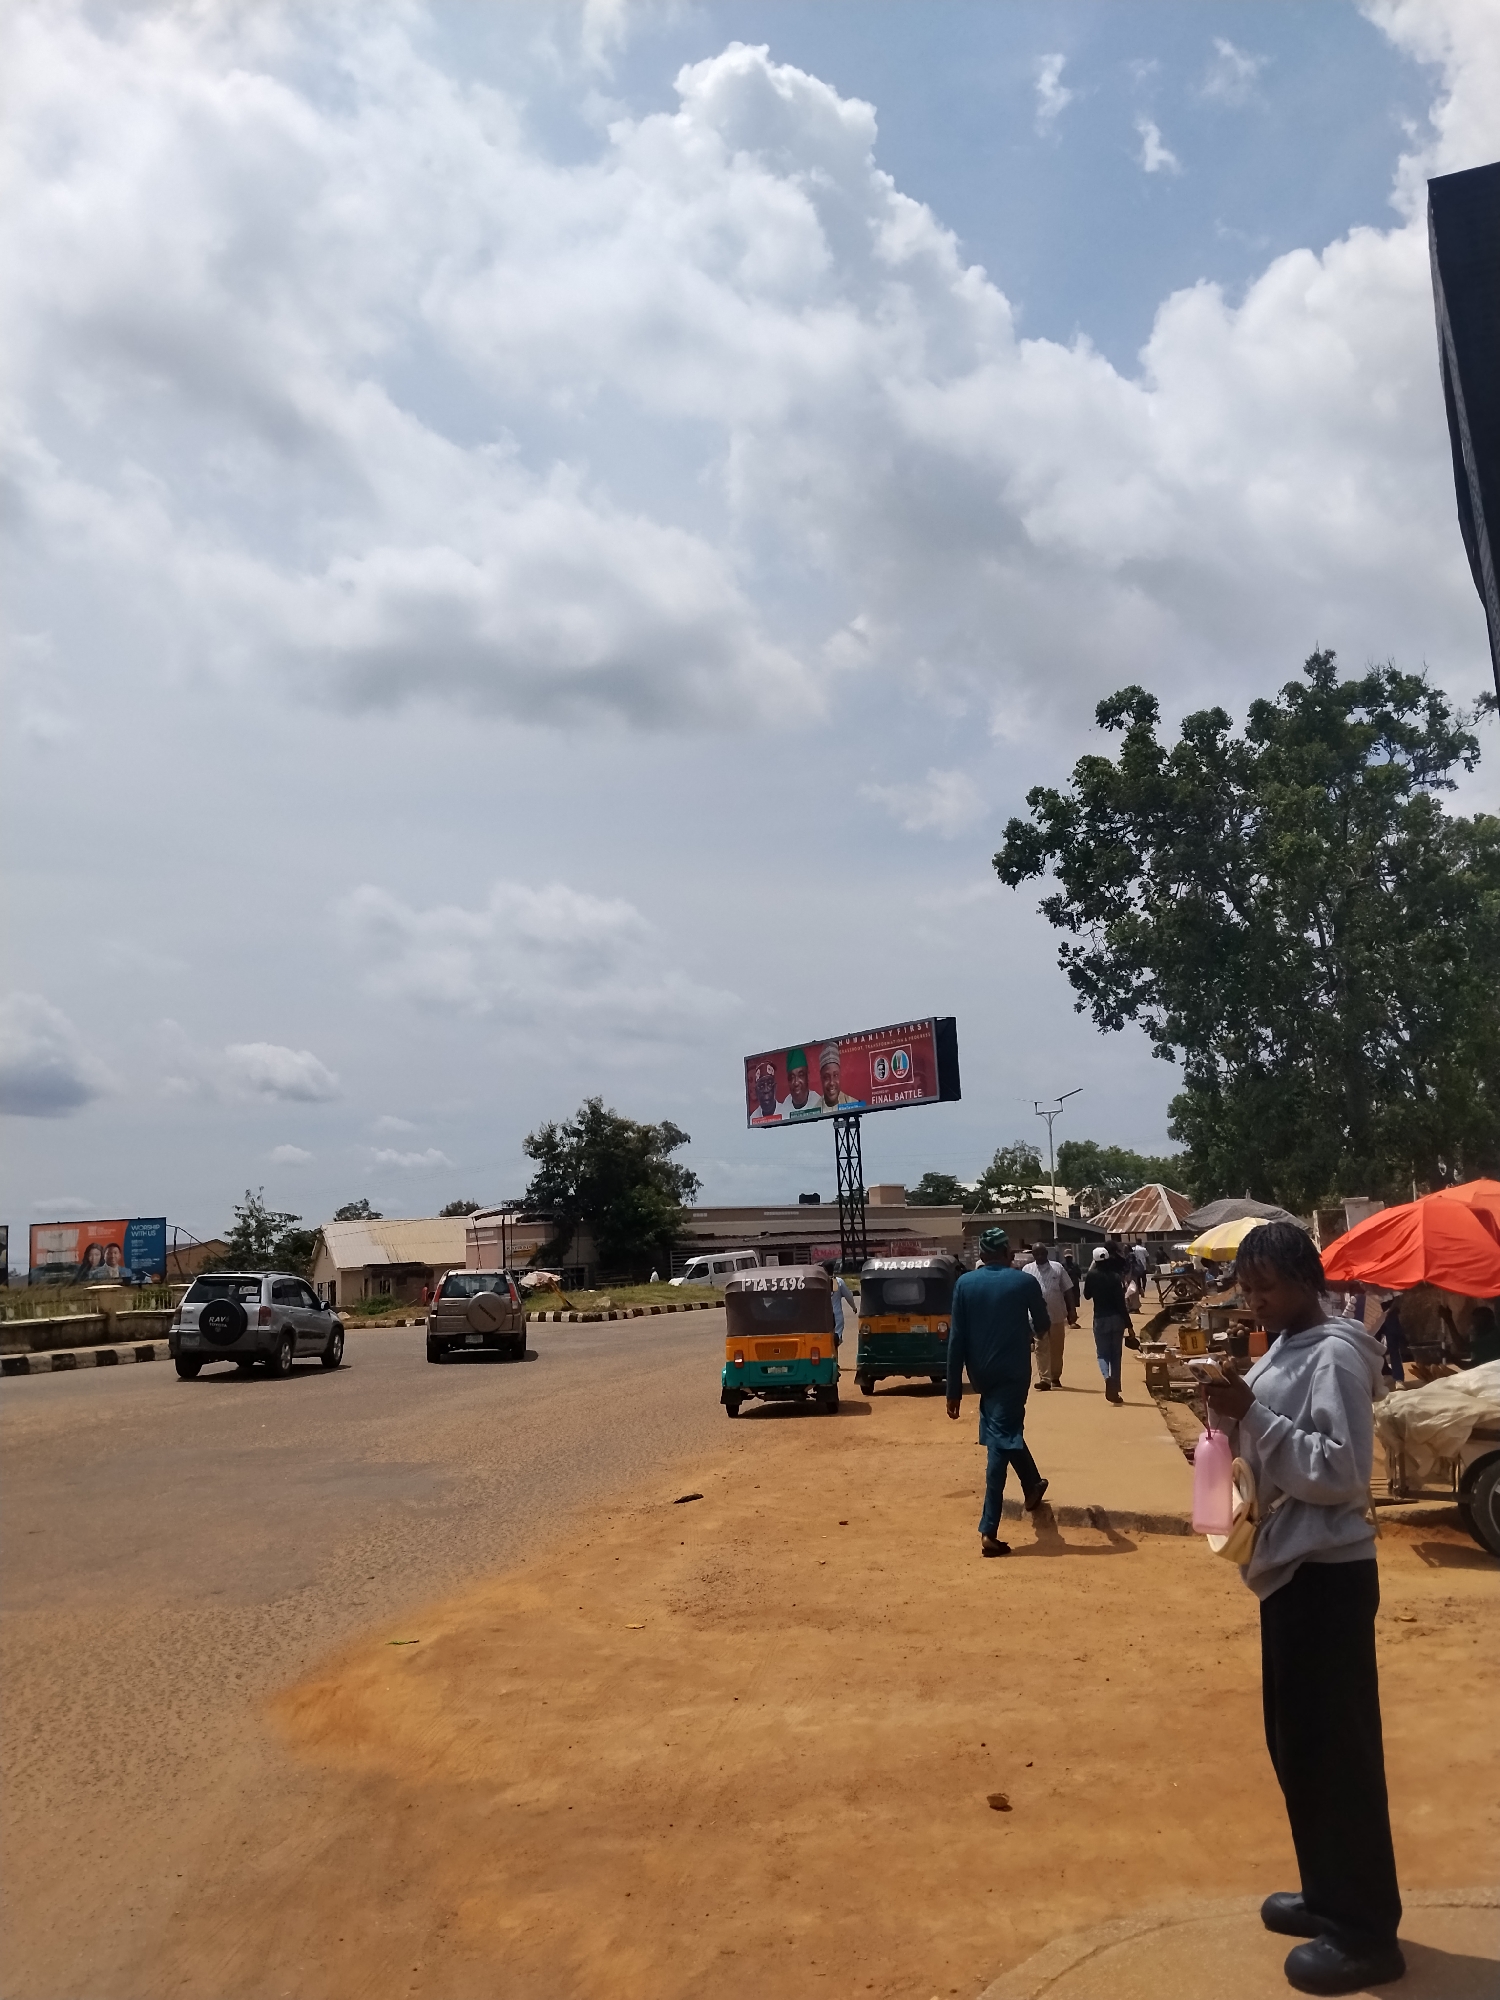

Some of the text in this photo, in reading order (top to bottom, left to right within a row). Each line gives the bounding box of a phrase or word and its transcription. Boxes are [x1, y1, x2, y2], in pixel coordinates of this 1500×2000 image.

[871, 1089, 922, 1104] FINAL BATTLE
[874, 1260, 897, 1270] PTA
